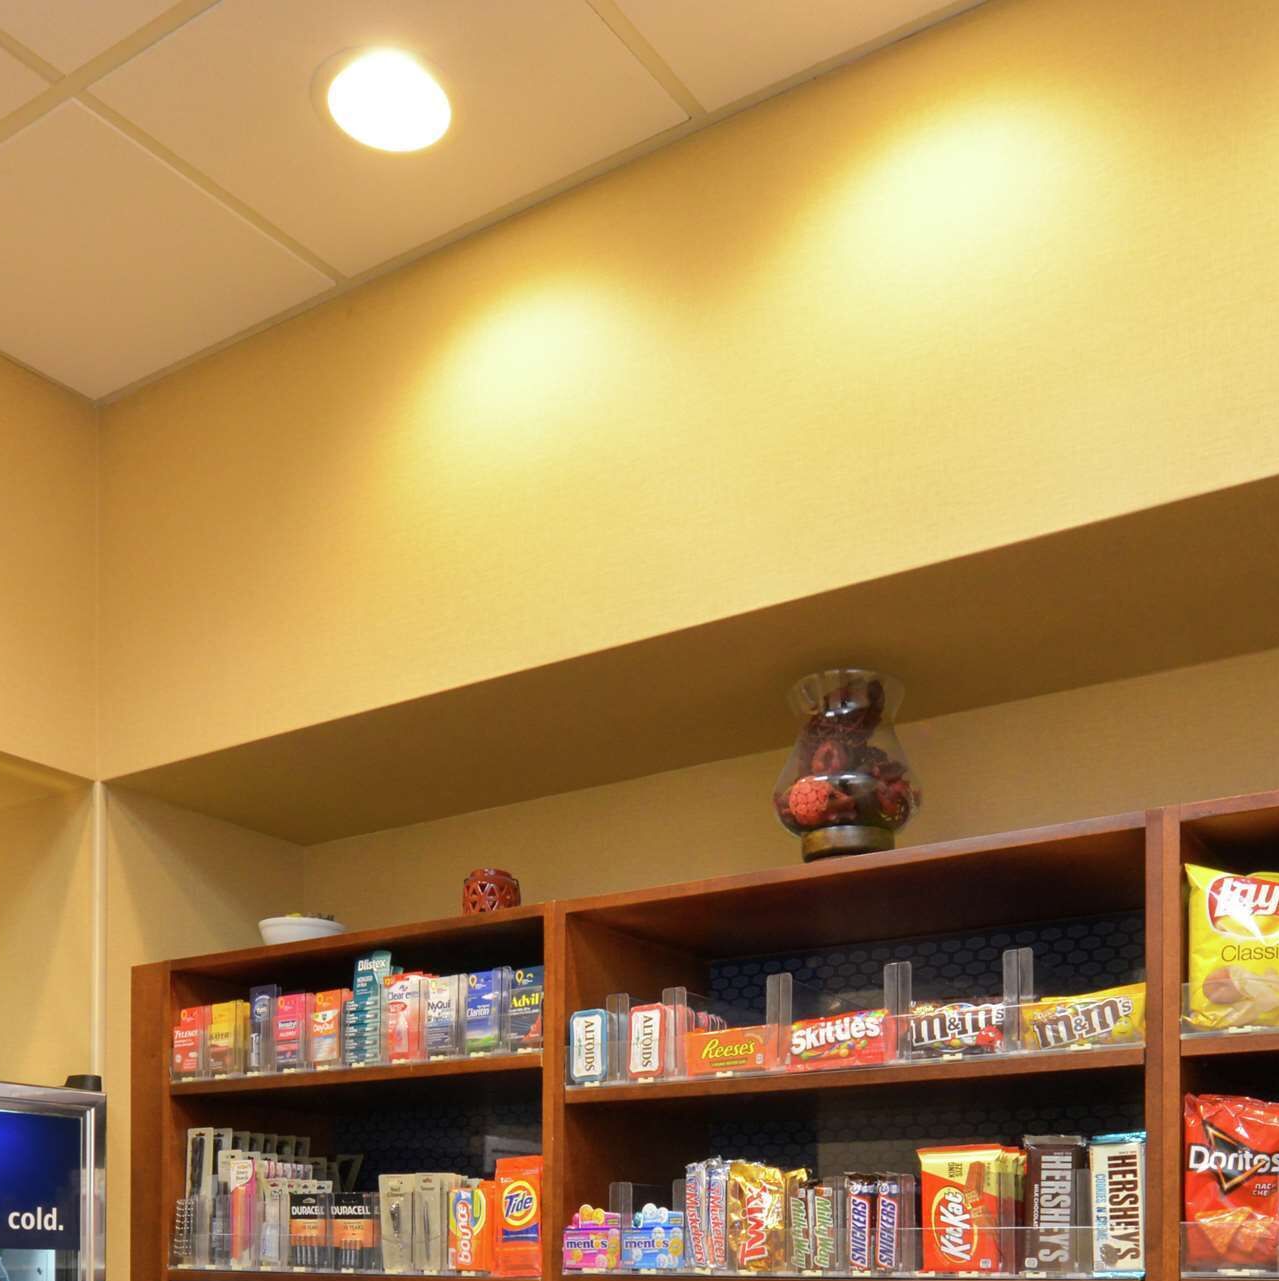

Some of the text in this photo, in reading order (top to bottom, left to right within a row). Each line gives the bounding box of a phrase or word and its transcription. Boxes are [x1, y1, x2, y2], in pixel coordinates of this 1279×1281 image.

[358, 959, 386, 971] Blistex
[511, 992, 541, 1008] Advil
[642, 1015, 653, 1068] ALTOIDS
[791, 1015, 884, 1053] Skittles
[911, 1003, 1005, 1047] m&m's
[1032, 997, 1132, 1049] m&m's
[584, 1020, 595, 1071] ALTOIDS
[701, 1038, 755, 1060] Reese's
[8, 1208, 63, 1231] cold.
[331, 1206, 370, 1215] DURACELL
[504, 1193, 533, 1218] Tide
[738, 1186, 770, 1267] TWIX
[1038, 1155, 1072, 1264] HERSHEY'S
[1107, 1153, 1141, 1261] HERSHEY'S
[456, 1201, 471, 1264] bounce
[566, 1241, 607, 1249] mentos
[625, 1239, 670, 1249] mentos
[850, 1198, 869, 1265] SNICKERS
[878, 1200, 896, 1267] SNICKERS
